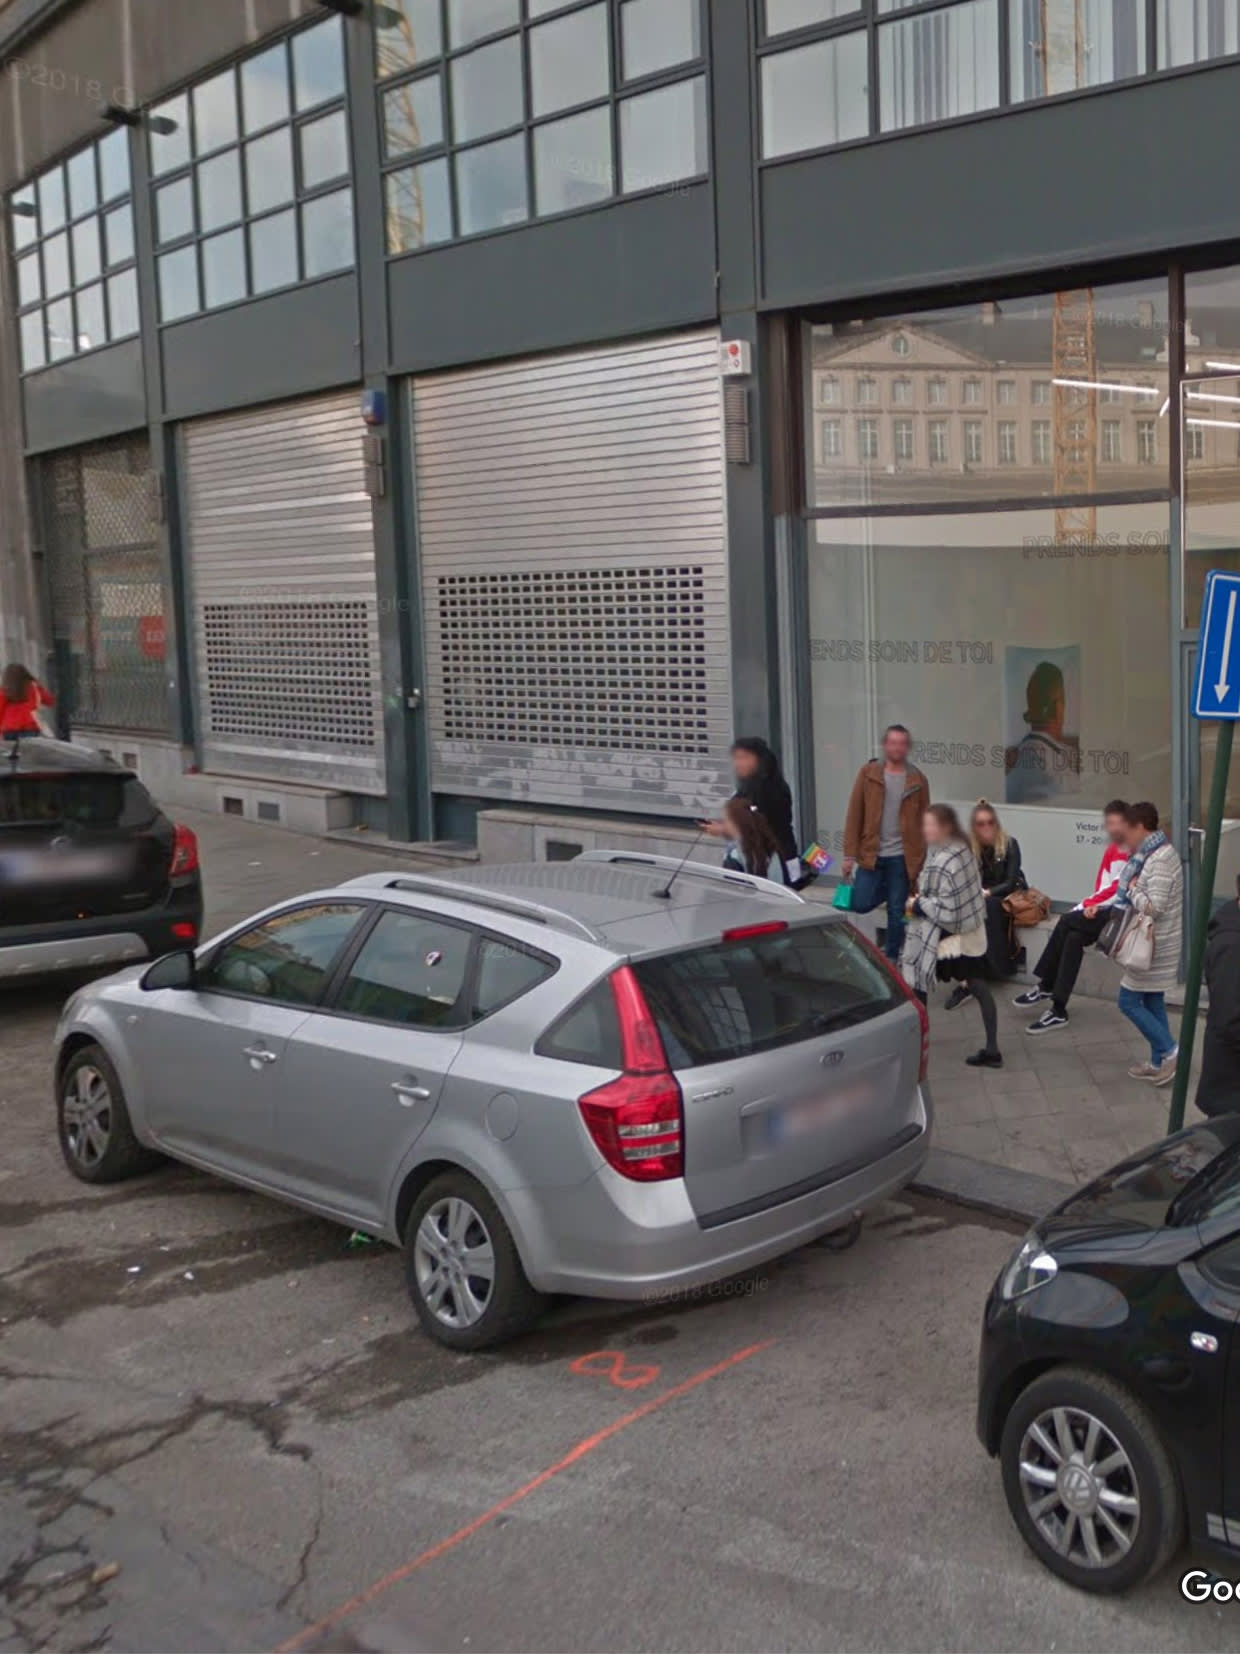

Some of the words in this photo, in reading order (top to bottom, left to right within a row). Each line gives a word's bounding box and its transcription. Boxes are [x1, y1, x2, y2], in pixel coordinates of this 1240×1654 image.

[1022, 531, 1120, 560] PRENDS
[1126, 529, 1171, 558] SOI
[810, 638, 865, 663] ENDS
[868, 639, 919, 664] SOIN
[923, 640, 953, 664] DE
[956, 640, 993, 665] TOI
[912, 740, 986, 767] RENDS
[991, 745, 1046, 771] SOIN
[1053, 749, 1084, 774] DE
[1089, 750, 1129, 775] TOI
